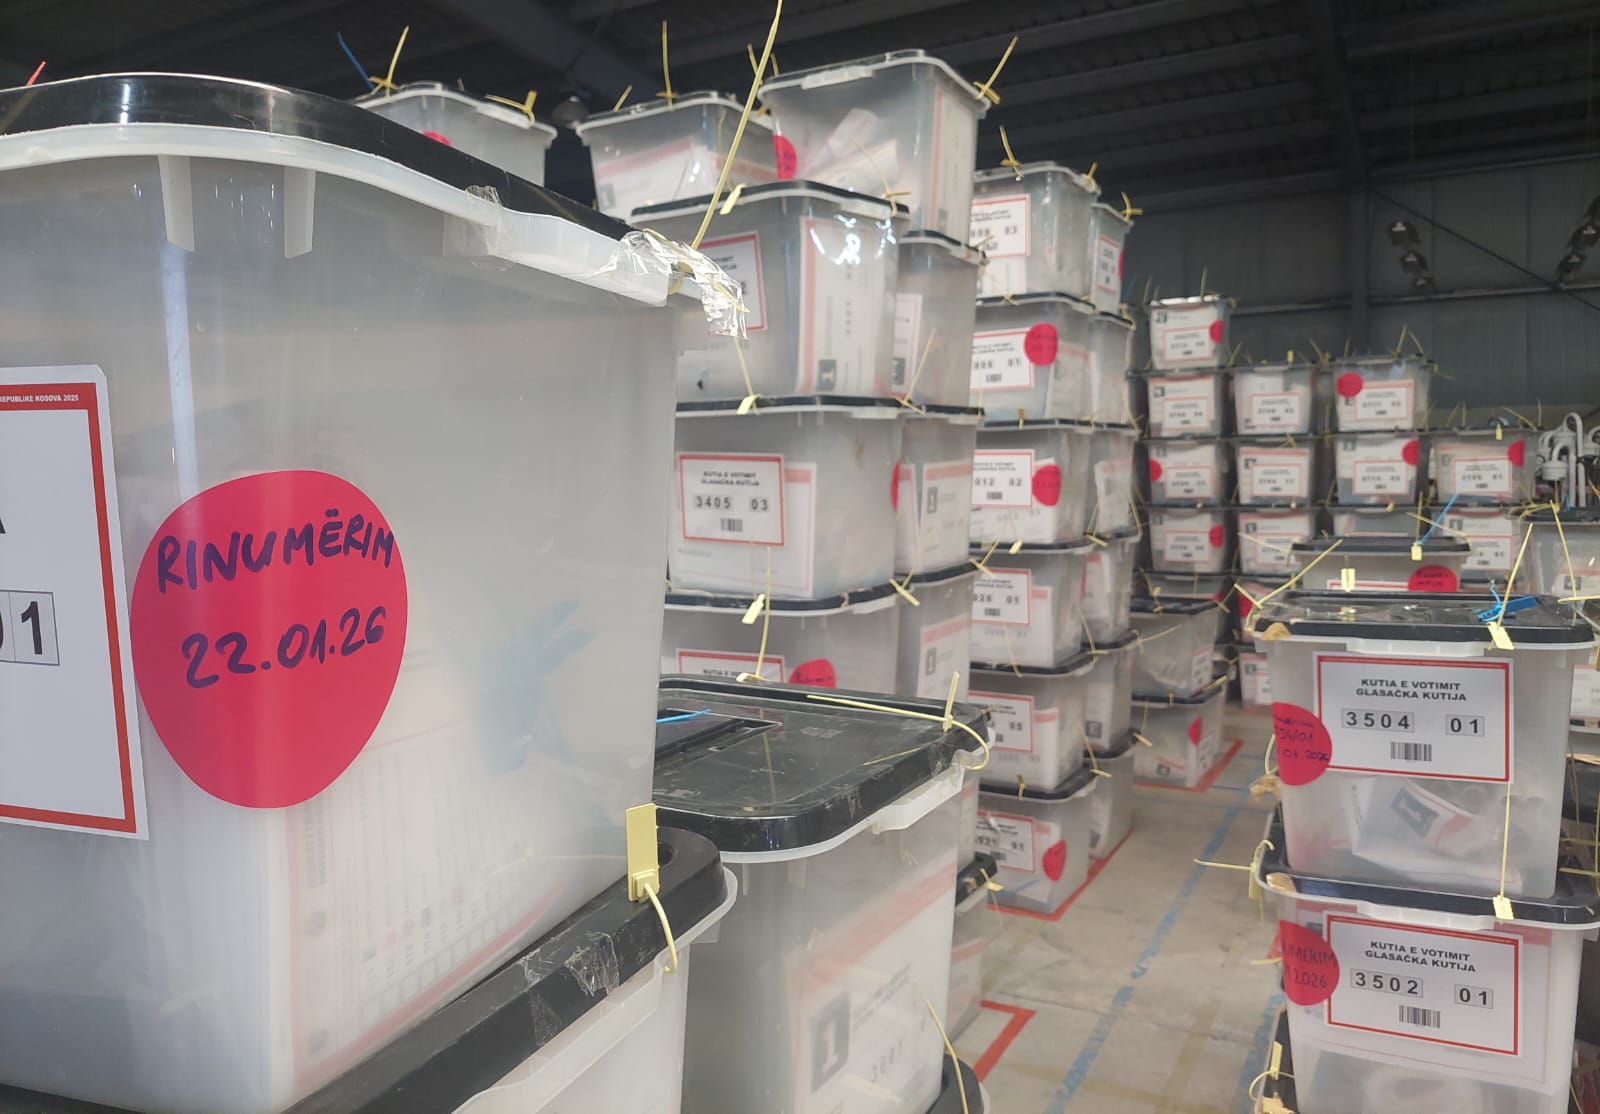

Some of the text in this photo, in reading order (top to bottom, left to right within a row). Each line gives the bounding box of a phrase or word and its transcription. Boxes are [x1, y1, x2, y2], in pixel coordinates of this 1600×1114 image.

[35, 394, 61, 403] KOSOVA
[696, 495, 769, 511] 3405 03
[157, 508, 394, 593] RINUMËRIM
[0, 600, 43, 655] 1
[181, 606, 388, 689] 22.01.26
[1361, 679, 1461, 690] KUTIA E VOTIMIT
[1423, 691, 1467, 701] KUTIJA
[1346, 711, 1479, 734] 3504 01
[1370, 941, 1470, 961] KUTIA E VOTIMIT
[1431, 959, 1476, 972] KUTIJA
[1355, 972, 1488, 1006] 3502 01
